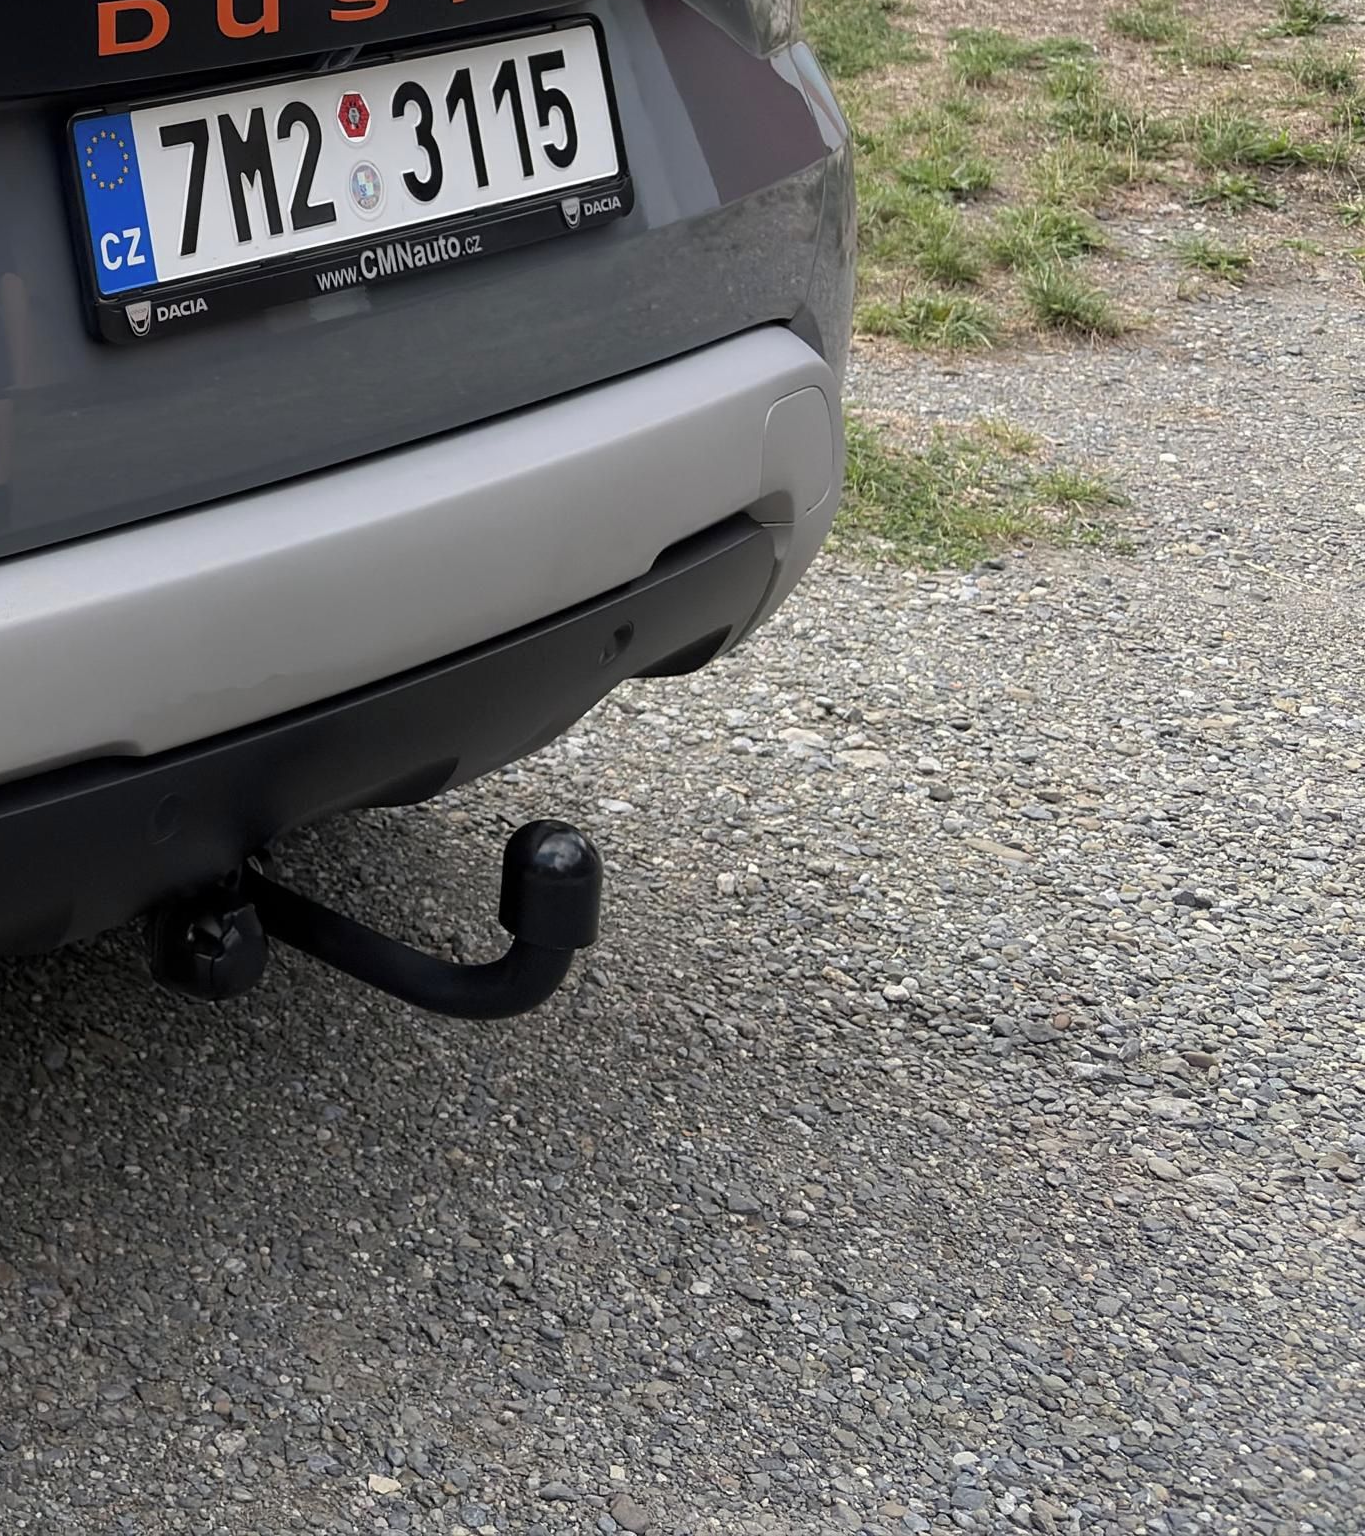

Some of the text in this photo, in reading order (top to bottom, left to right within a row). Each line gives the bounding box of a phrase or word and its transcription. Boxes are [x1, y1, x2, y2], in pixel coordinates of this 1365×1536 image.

[160, 49, 578, 257] 7M2 3115
[584, 196, 622, 216] DACIA
[100, 227, 146, 270] CZ
[316, 235, 483, 291] www.CMNauto.cz
[156, 297, 209, 322] DACIA
